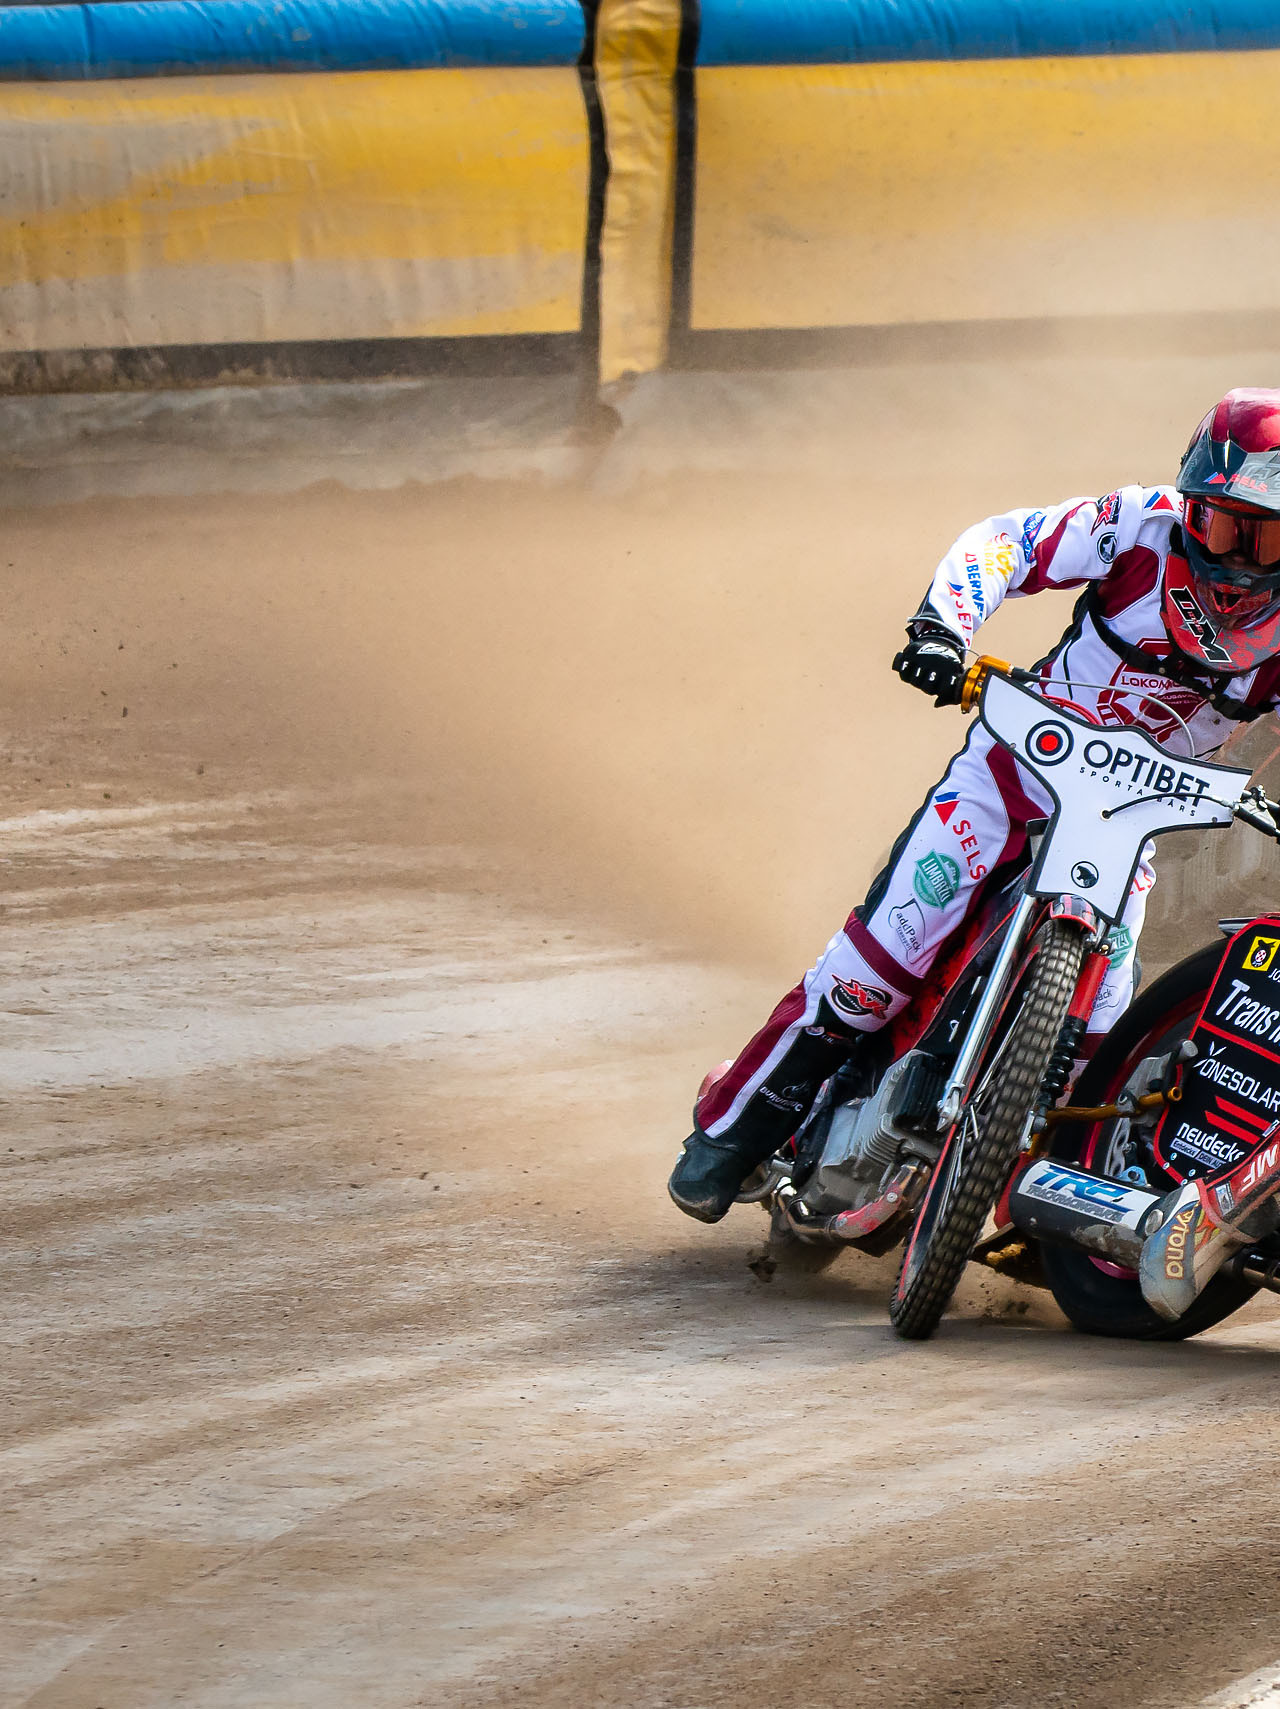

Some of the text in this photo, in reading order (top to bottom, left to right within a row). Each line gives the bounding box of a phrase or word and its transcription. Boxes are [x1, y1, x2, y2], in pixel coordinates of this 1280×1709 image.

[1229, 474, 1268, 493] SELS
[901, 661, 956, 685] FIST
[1079, 766, 1144, 796] SPORTA
[1083, 739, 1210, 808] OPTIBET
[952, 819, 987, 880] SELS
[1215, 979, 1280, 1035] Trans
[1241, 1144, 1278, 1192] MF
